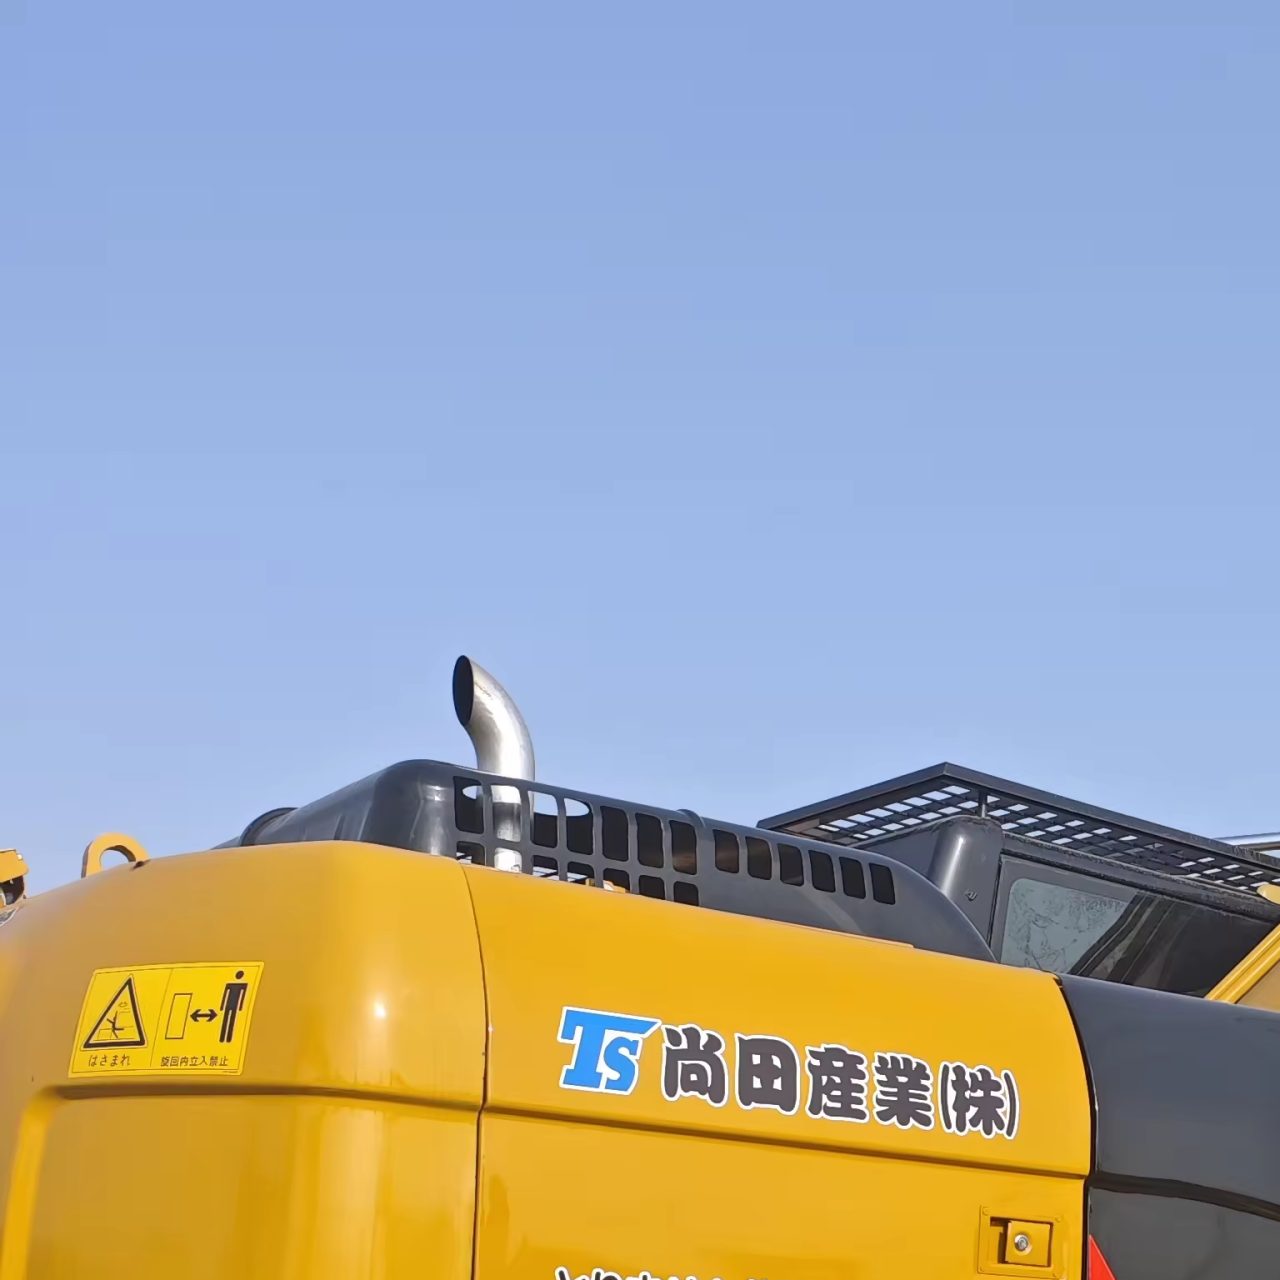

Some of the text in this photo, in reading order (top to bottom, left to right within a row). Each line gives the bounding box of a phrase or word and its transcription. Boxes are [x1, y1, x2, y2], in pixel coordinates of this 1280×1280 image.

[88, 1054, 131, 1067] はさまれ
[160, 1055, 229, 1067] 旋回内立入禁止
